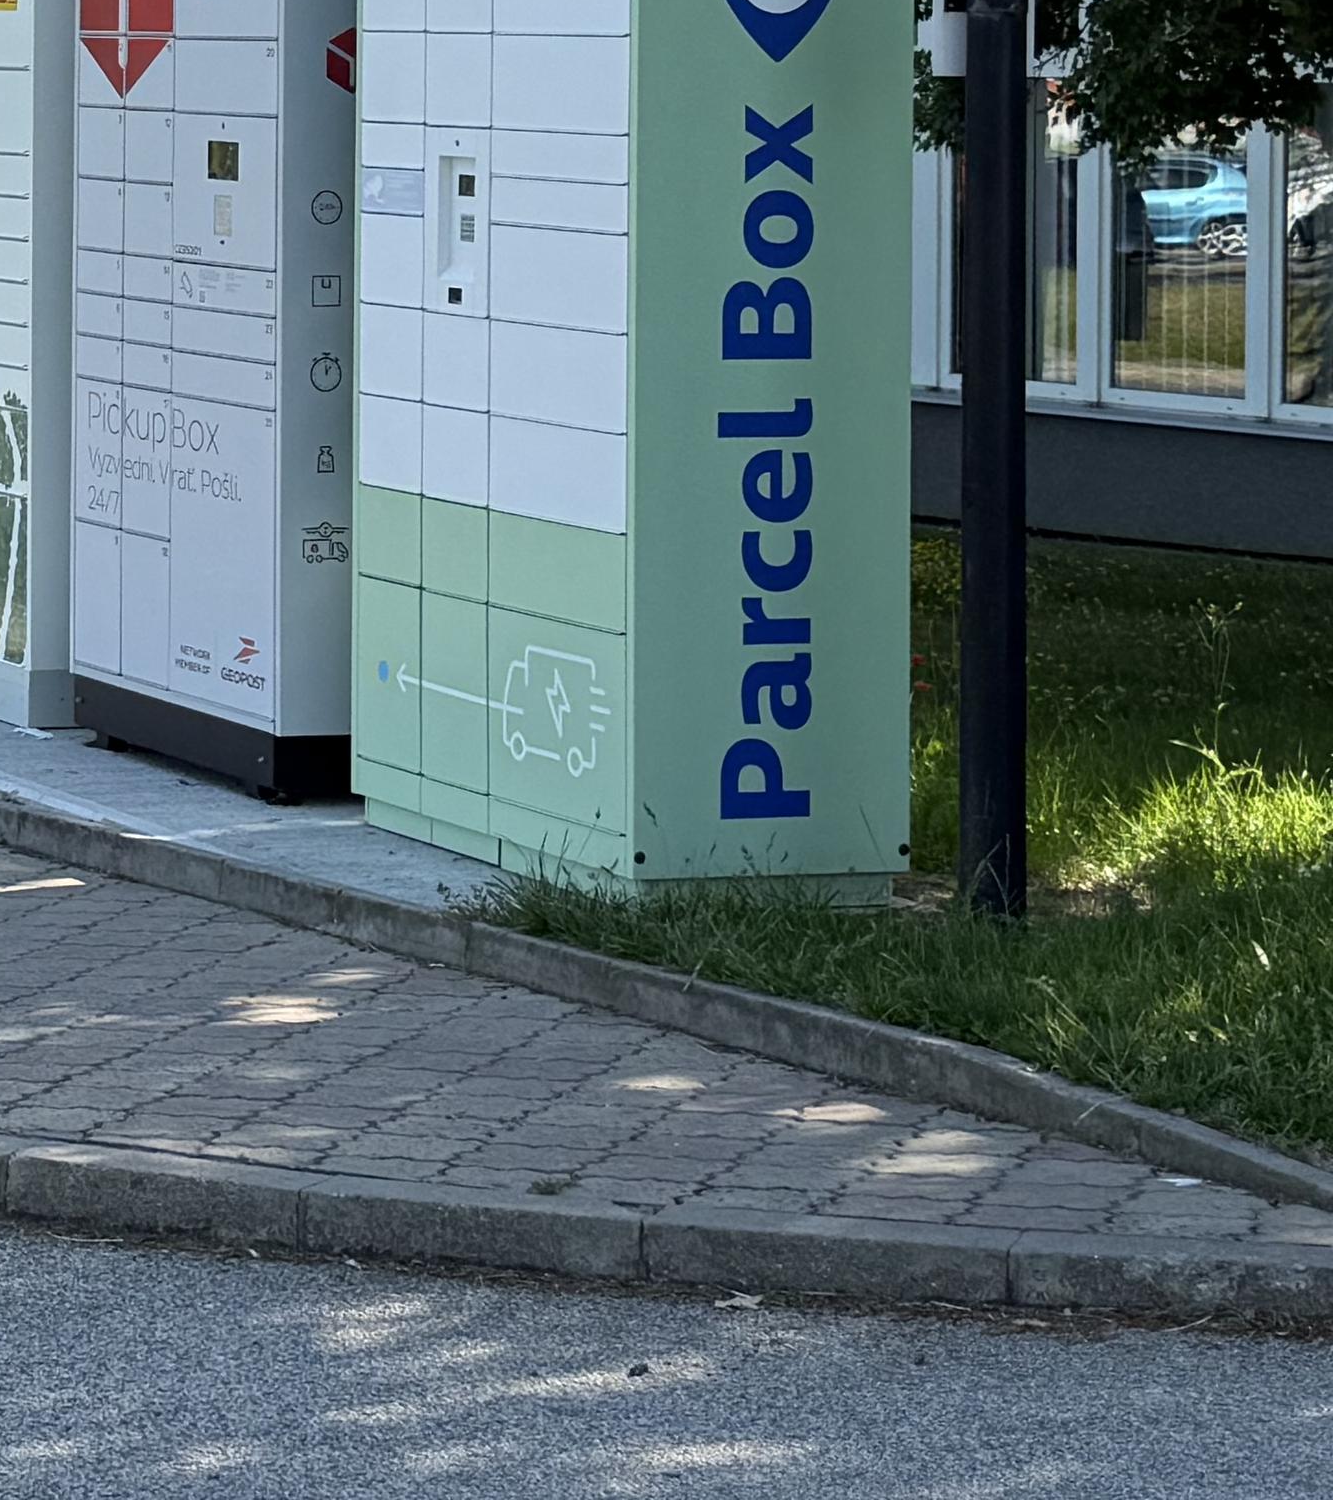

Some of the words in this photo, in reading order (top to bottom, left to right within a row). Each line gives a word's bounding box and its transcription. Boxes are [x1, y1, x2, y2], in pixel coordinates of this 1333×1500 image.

[722, 103, 814, 360] Box
[88, 445, 156, 484] Vyzvedni.
[201, 469, 242, 502] Pošli.
[88, 485, 120, 515] 24/7
[717, 397, 814, 820] Parcel
[221, 667, 266, 691] GEOPOST
